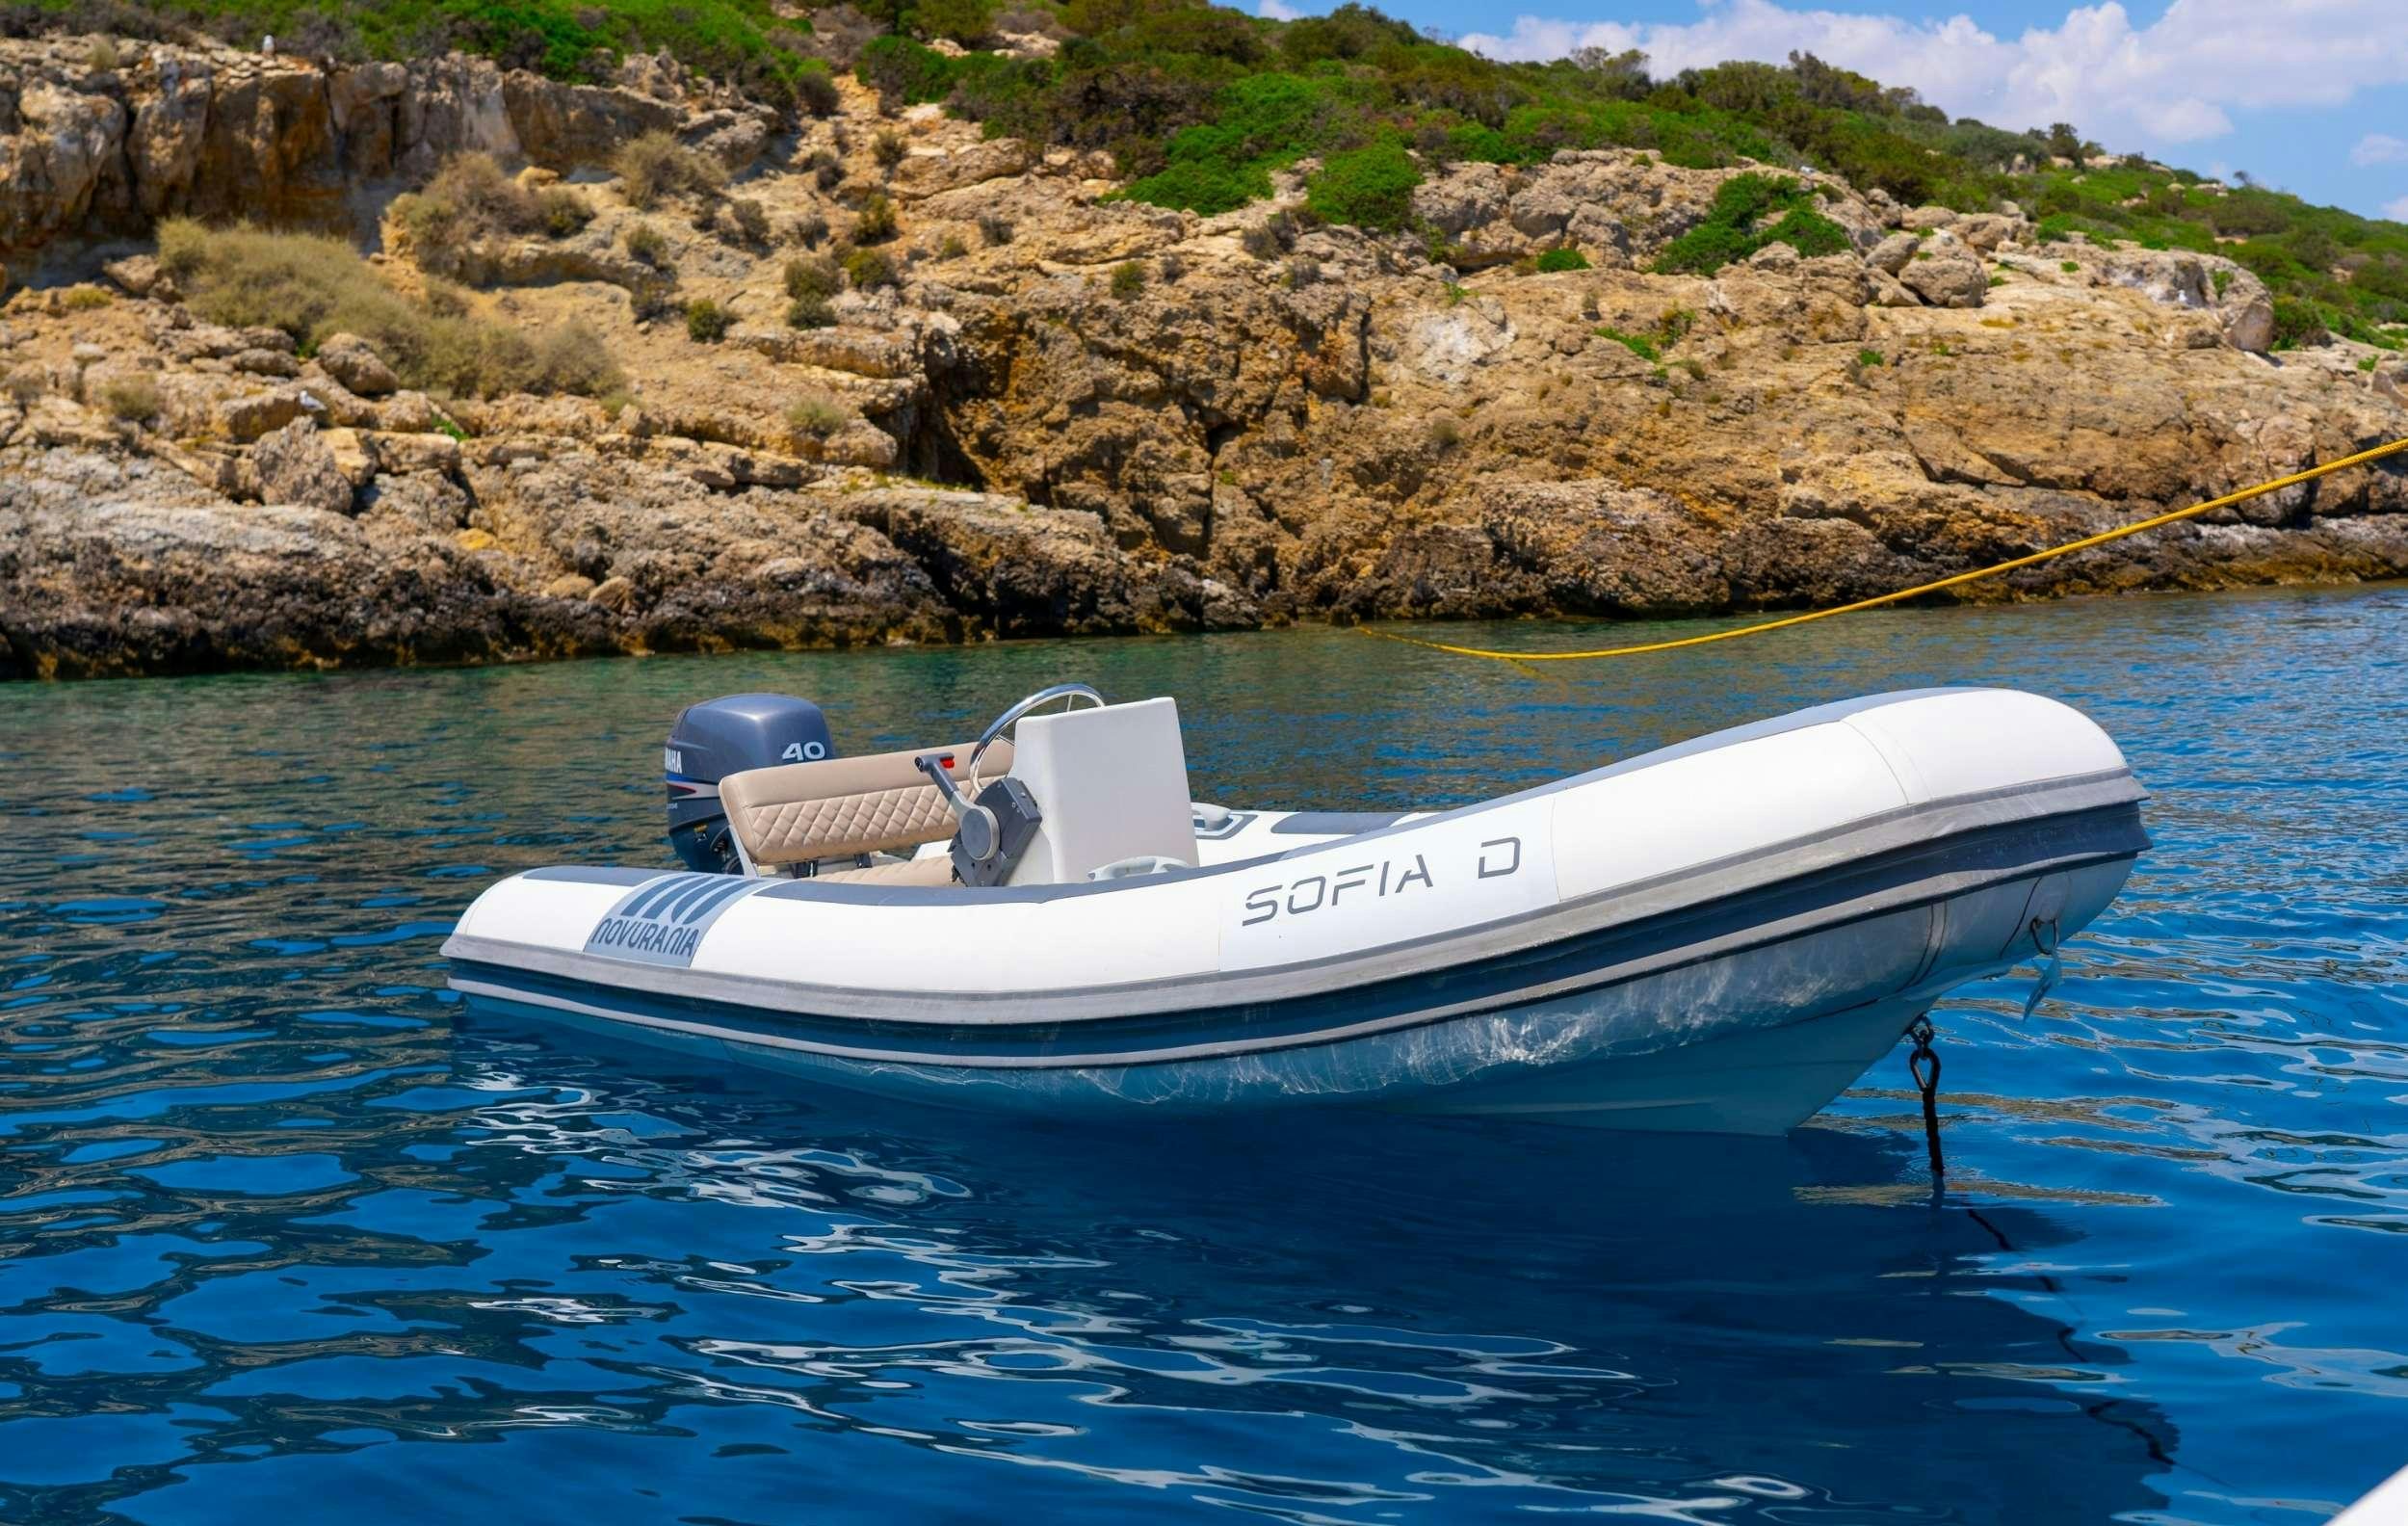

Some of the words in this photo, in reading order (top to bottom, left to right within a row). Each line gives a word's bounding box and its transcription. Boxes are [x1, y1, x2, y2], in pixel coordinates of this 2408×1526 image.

[782, 741, 825, 761] 40
[1242, 854, 1433, 927] SOFIA
[1478, 836, 1521, 879] D
